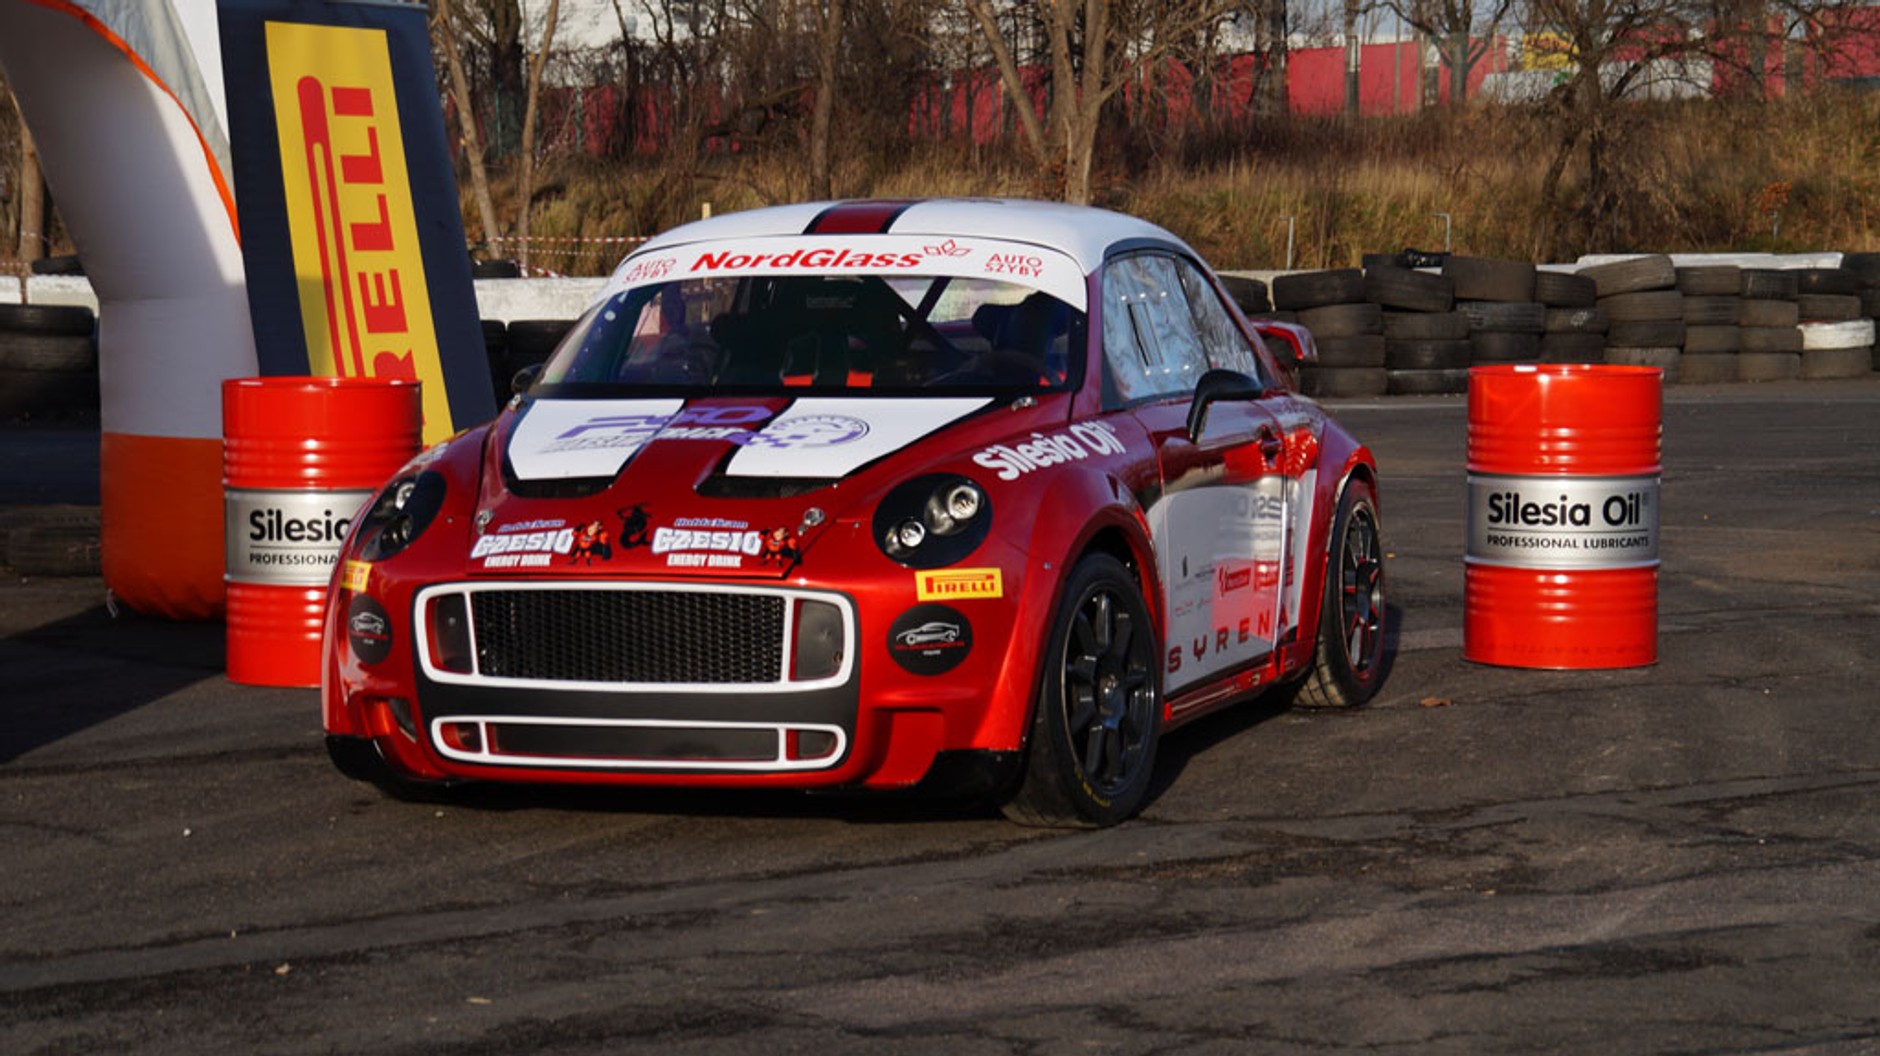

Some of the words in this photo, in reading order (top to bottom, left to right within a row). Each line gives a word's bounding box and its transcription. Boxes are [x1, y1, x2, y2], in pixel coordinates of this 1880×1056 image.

[297, 75, 420, 380] PELLI
[632, 256, 677, 272] AUTO
[690, 248, 924, 272] NordGlass
[984, 262, 1043, 277] SZYBY
[988, 253, 1042, 267] AUTO
[972, 433, 1088, 481] Silesia
[1487, 492, 1591, 527] Silesia
[1486, 534, 1580, 549] PROFESSIONAL
[1583, 535, 1649, 549] LUBRICANTS
[249, 552, 338, 566] PROFESSIONA
[924, 573, 995, 594] PIRELLI
[1167, 602, 1289, 674] SYRENA
